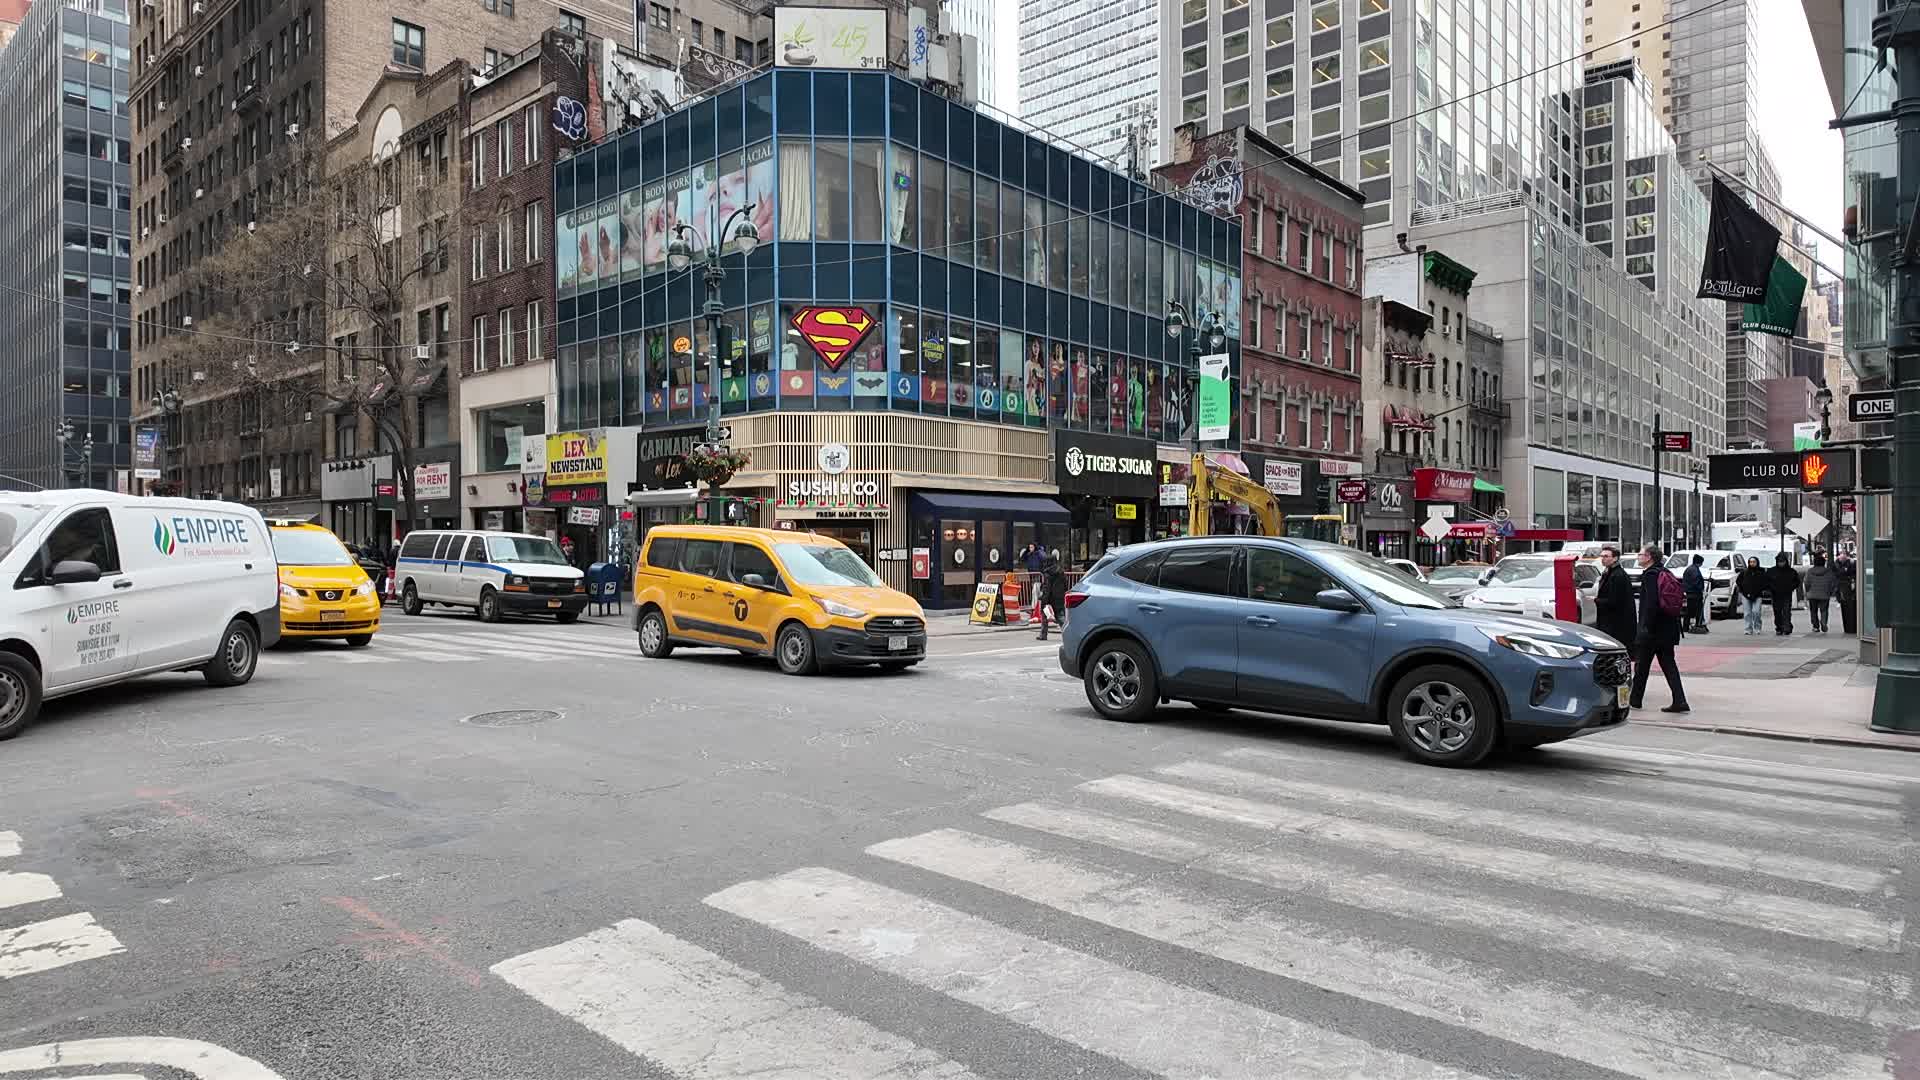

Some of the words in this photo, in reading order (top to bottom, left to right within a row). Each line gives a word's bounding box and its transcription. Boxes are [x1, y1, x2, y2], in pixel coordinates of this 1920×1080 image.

[860, 56, 874, 68] 3rd
[740, 144, 771, 165] FACIAL
[645, 175, 690, 199] BODYWORK
[1703, 279, 1763, 298] Boutique
[1860, 400, 1892, 414] ONE
[564, 439, 586, 458] LEX
[550, 457, 603, 474] NEWSSTAND
[1085, 454, 1117, 473] TIGER
[1118, 457, 1152, 476] SUGAR
[1265, 464, 1281, 477] SPACE
[1287, 466, 1300, 478] RENT
[1743, 465, 1776, 477] CLUB
[426, 473, 448, 485] RENT
[789, 481, 838, 496] SUSHI
[841, 482, 849, 496] &
[853, 481, 877, 496] CO
[173, 518, 248, 542] EMPIRE
[78, 600, 119, 617] EMPIRE
